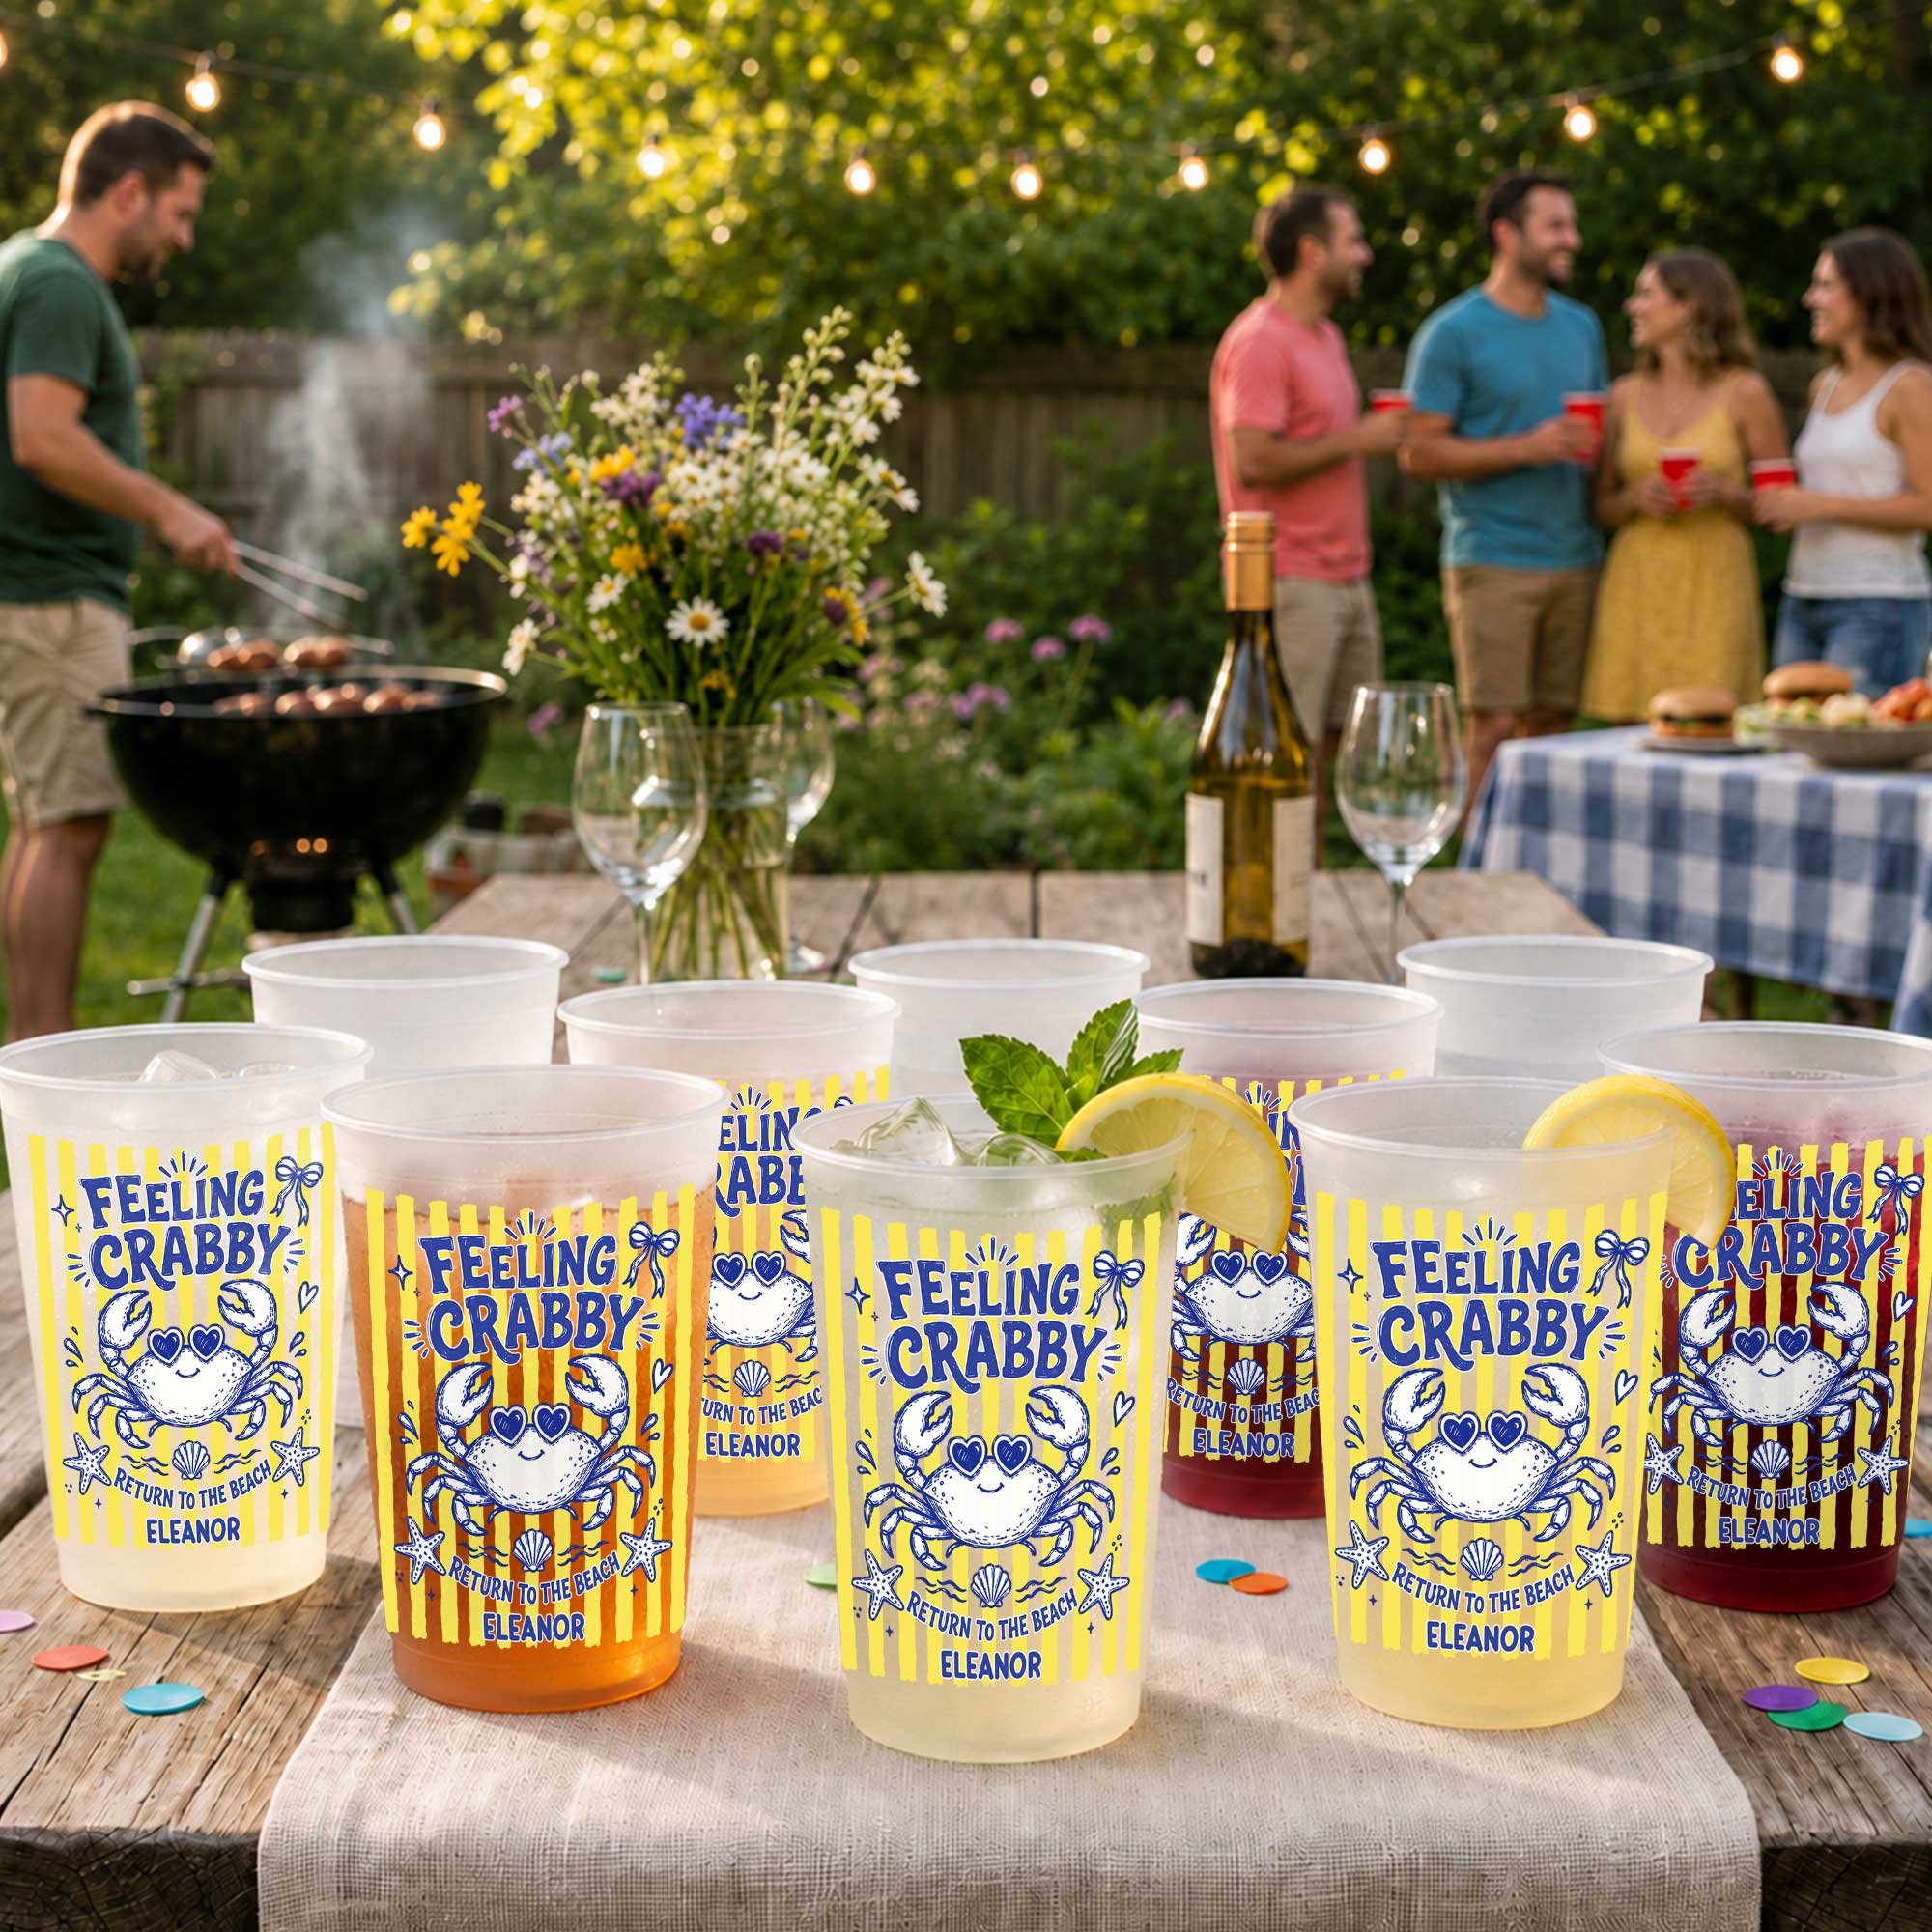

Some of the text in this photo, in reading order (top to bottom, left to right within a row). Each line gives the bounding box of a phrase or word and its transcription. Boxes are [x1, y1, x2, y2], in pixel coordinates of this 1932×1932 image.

[718, 1107, 822, 1152] ELIN
[80, 1170, 264, 1230] FEELING
[1731, 1172, 1861, 1220] ELING
[90, 1223, 292, 1291] CRABBY
[419, 1235, 616, 1295] FEELING
[1372, 1240, 1581, 1299] FEELING
[1672, 1222, 1889, 1290] CRABBY
[877, 1259, 1080, 1321] FEELING
[428, 1291, 645, 1365] CRABBY
[1378, 1298, 1610, 1372] CRABBY
[886, 1320, 1108, 1394] CRABBY
[703, 1387, 822, 1425] URN TO THE BEAC
[1167, 1378, 1319, 1423] RETURN TO THE BEAC
[705, 1432, 800, 1458] ELEANOR
[1193, 1428, 1294, 1457] ELEANOR
[113, 1459, 272, 1510] RETURN TO THE BEACH
[1686, 1463, 1857, 1509] RETURN TO THE BEACH
[146, 1516, 241, 1544] ELEANOR
[1719, 1517, 1820, 1544] ELEANOR
[448, 1551, 620, 1605] RETURN TO THE BEACH
[1391, 1562, 1575, 1614] RETURN TO THE BEACH
[483, 1613, 585, 1641] ELEANOR
[906, 1588, 1078, 1641] RETURN TO THE BEACH
[1427, 1620, 1535, 1652] ELEANOR
[941, 1650, 1042, 1680] ELEANOR
